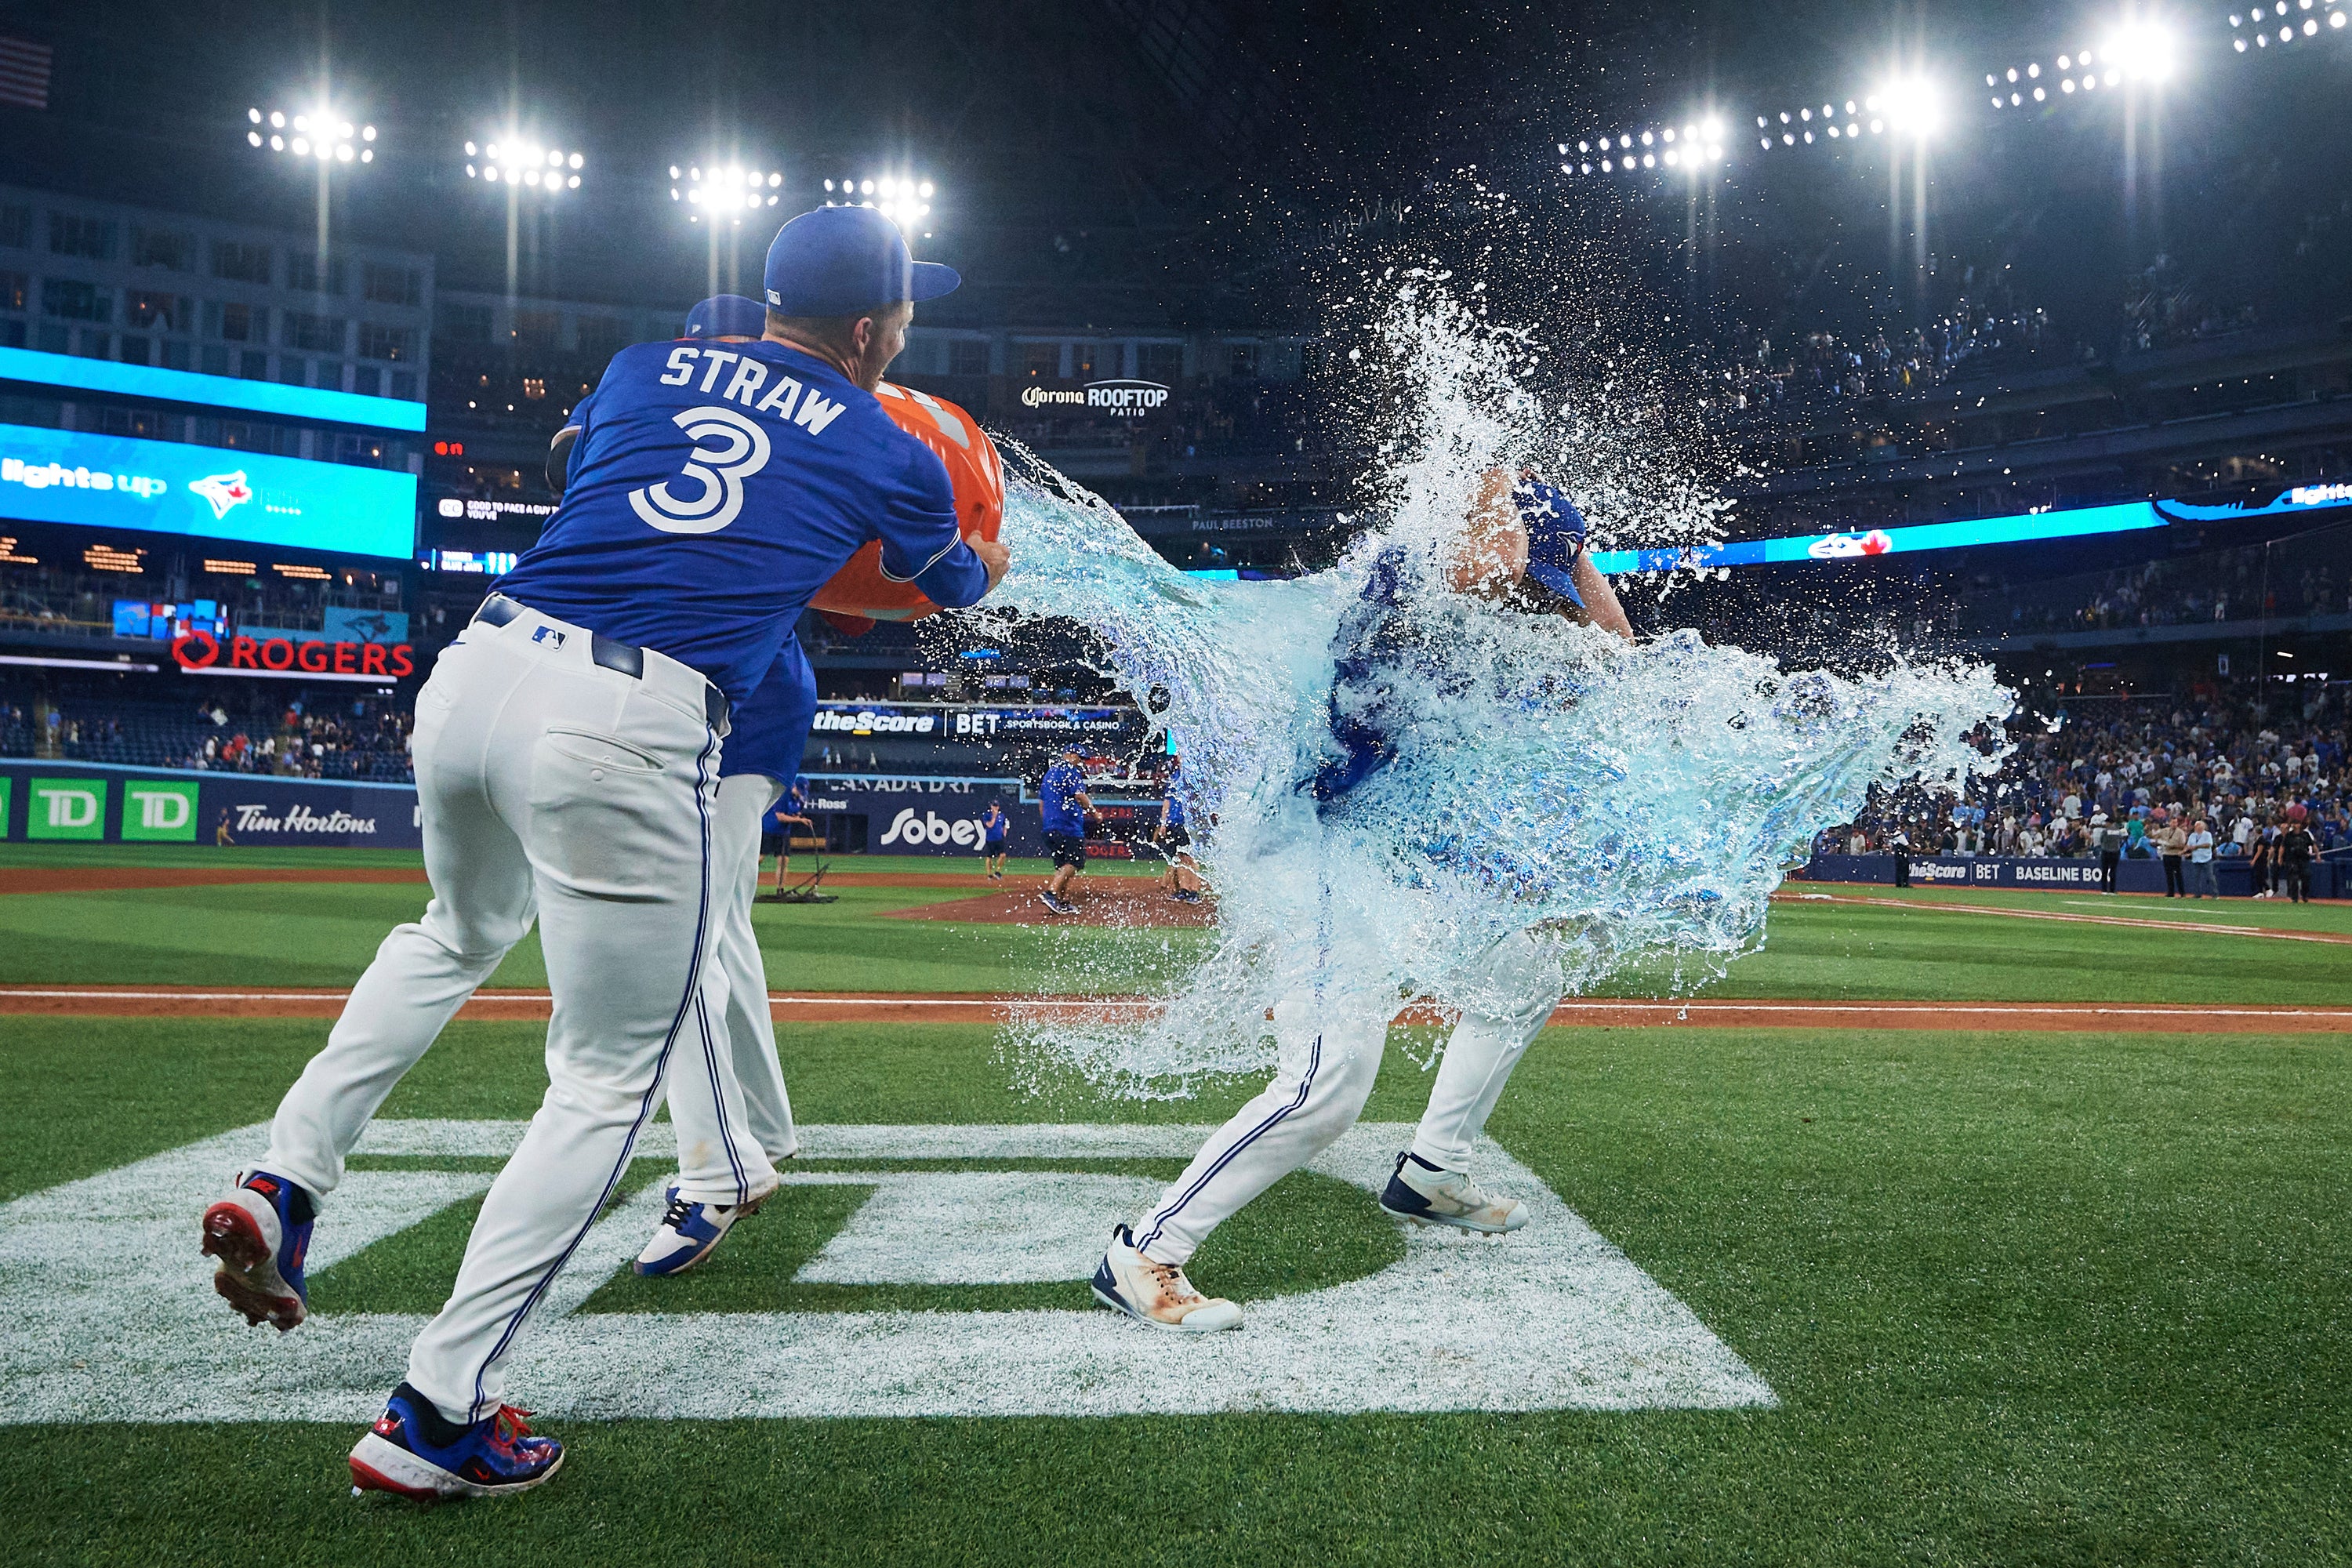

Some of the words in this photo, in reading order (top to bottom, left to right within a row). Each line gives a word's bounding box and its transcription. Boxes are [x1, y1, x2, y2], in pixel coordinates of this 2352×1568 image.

[659, 347, 847, 436] STRAW
[1022, 387, 1084, 408] Corona
[1088, 388, 1168, 407] ROOFTOP
[1110, 407, 1145, 417] PATIO
[2, 458, 114, 489] lights
[118, 474, 168, 498] up
[628, 406, 771, 534] 3
[467, 500, 492, 511] GOOD
[492, 502, 504, 512] TO
[526, 504, 533, 514] A
[1192, 519, 1220, 530] PAUL
[1223, 517, 1272, 529] BEESTON
[231, 636, 414, 677] ROGERS
[812, 711, 935, 732] theScore
[956, 713, 1000, 734] BET
[1006, 720, 1072, 730] SPORTSBOOK
[1073, 720, 1081, 730] &
[1083, 720, 1120, 730] CASINO
[38, 789, 97, 826] TD
[132, 792, 190, 828] TD
[236, 804, 281, 832] Tim
[283, 804, 376, 833] Hortons
[880, 808, 987, 851] Sobey
[1976, 864, 2000, 880] BET
[2016, 866, 2079, 882] BASELINE
